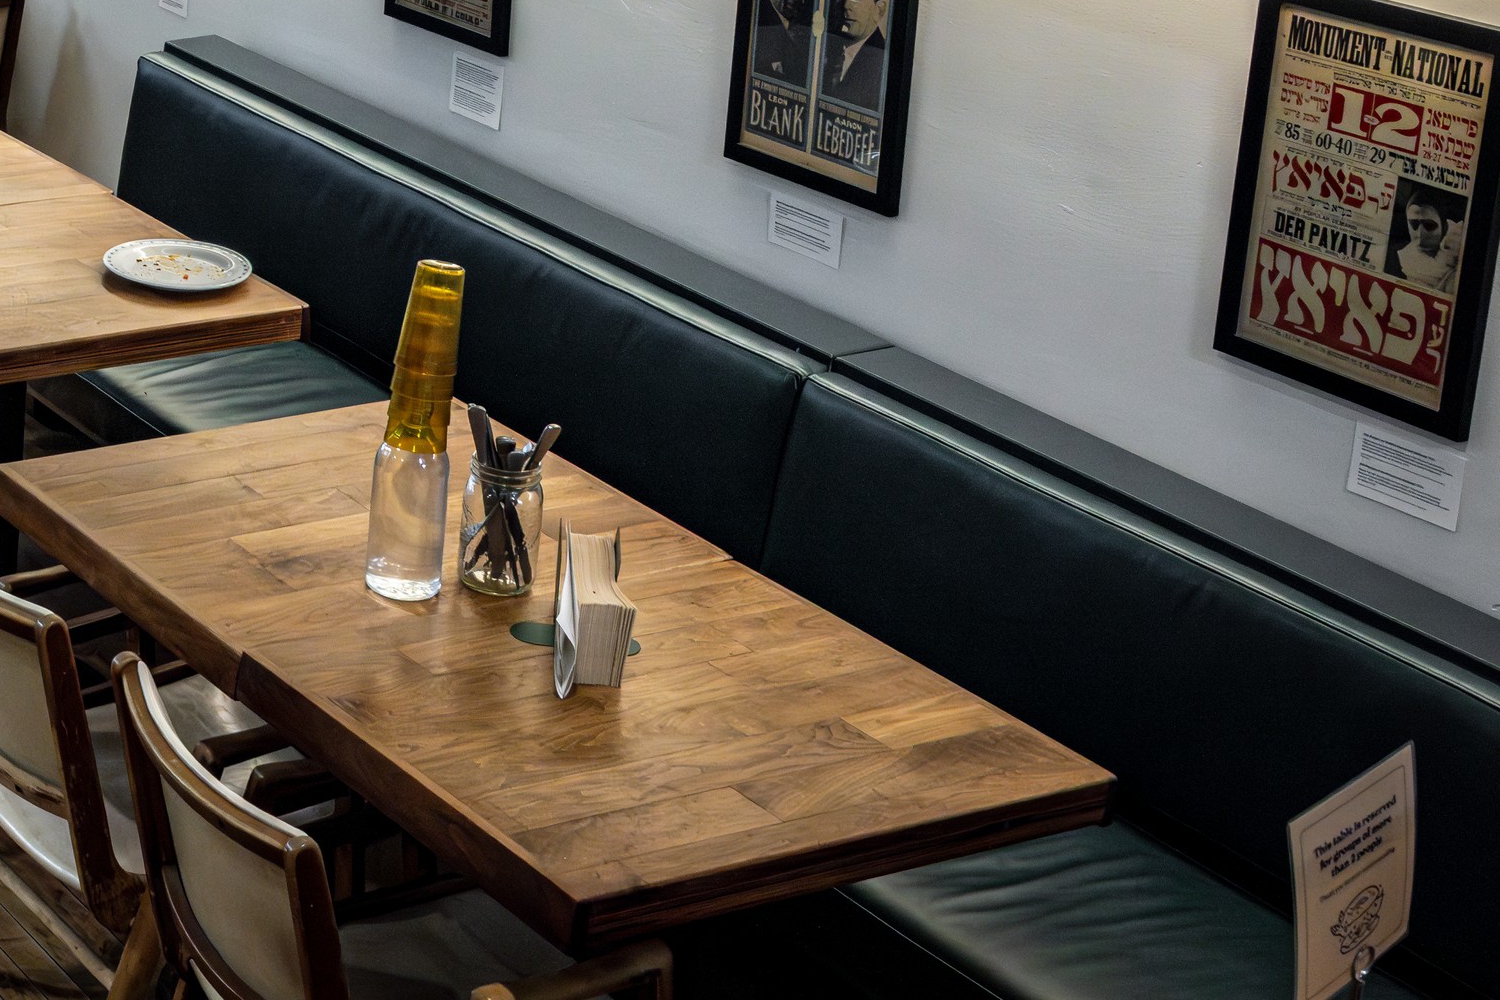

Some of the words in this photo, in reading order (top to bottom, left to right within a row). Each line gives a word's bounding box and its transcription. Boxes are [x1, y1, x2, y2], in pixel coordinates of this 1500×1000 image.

[1288, 13, 1387, 71] MONUMENT
[1391, 39, 1485, 98] NATIONAL
[750, 90, 805, 143] BLANK
[768, 94, 788, 106] LEON
[816, 112, 877, 166] LEBEDEFF
[1284, 122, 1301, 141] 85
[1315, 131, 1353, 155] 60-40
[1274, 211, 1306, 237] DER
[1308, 222, 1373, 263] PAYATZ
[1362, 794, 1396, 826] reserved
